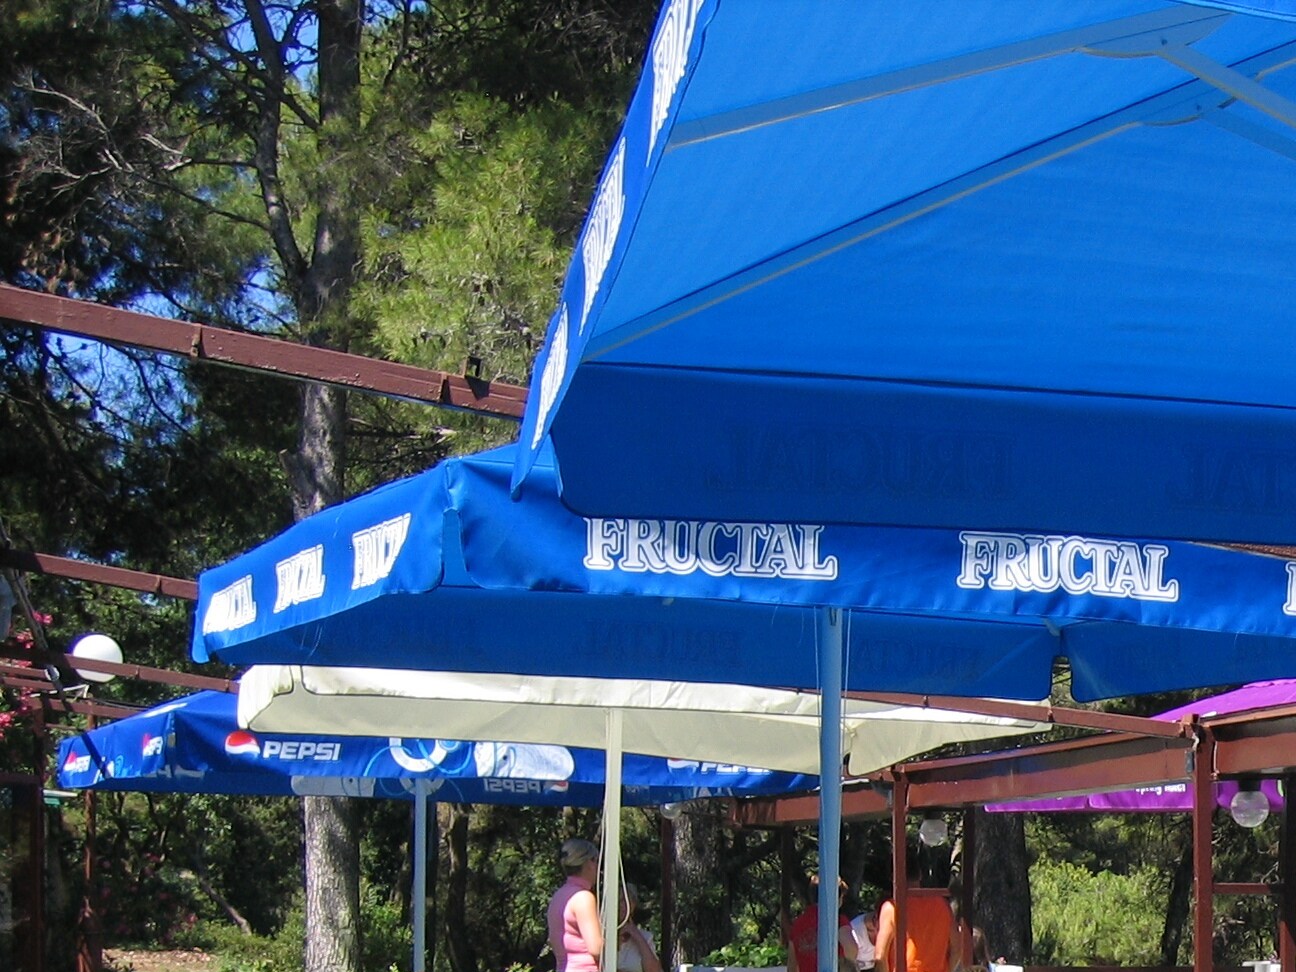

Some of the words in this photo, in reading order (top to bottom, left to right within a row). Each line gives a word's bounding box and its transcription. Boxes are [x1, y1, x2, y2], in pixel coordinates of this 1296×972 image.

[583, 517, 838, 581] FRUCTAL
[957, 531, 1179, 602] FRUCTAL
[262, 740, 341, 761] PEPSI
